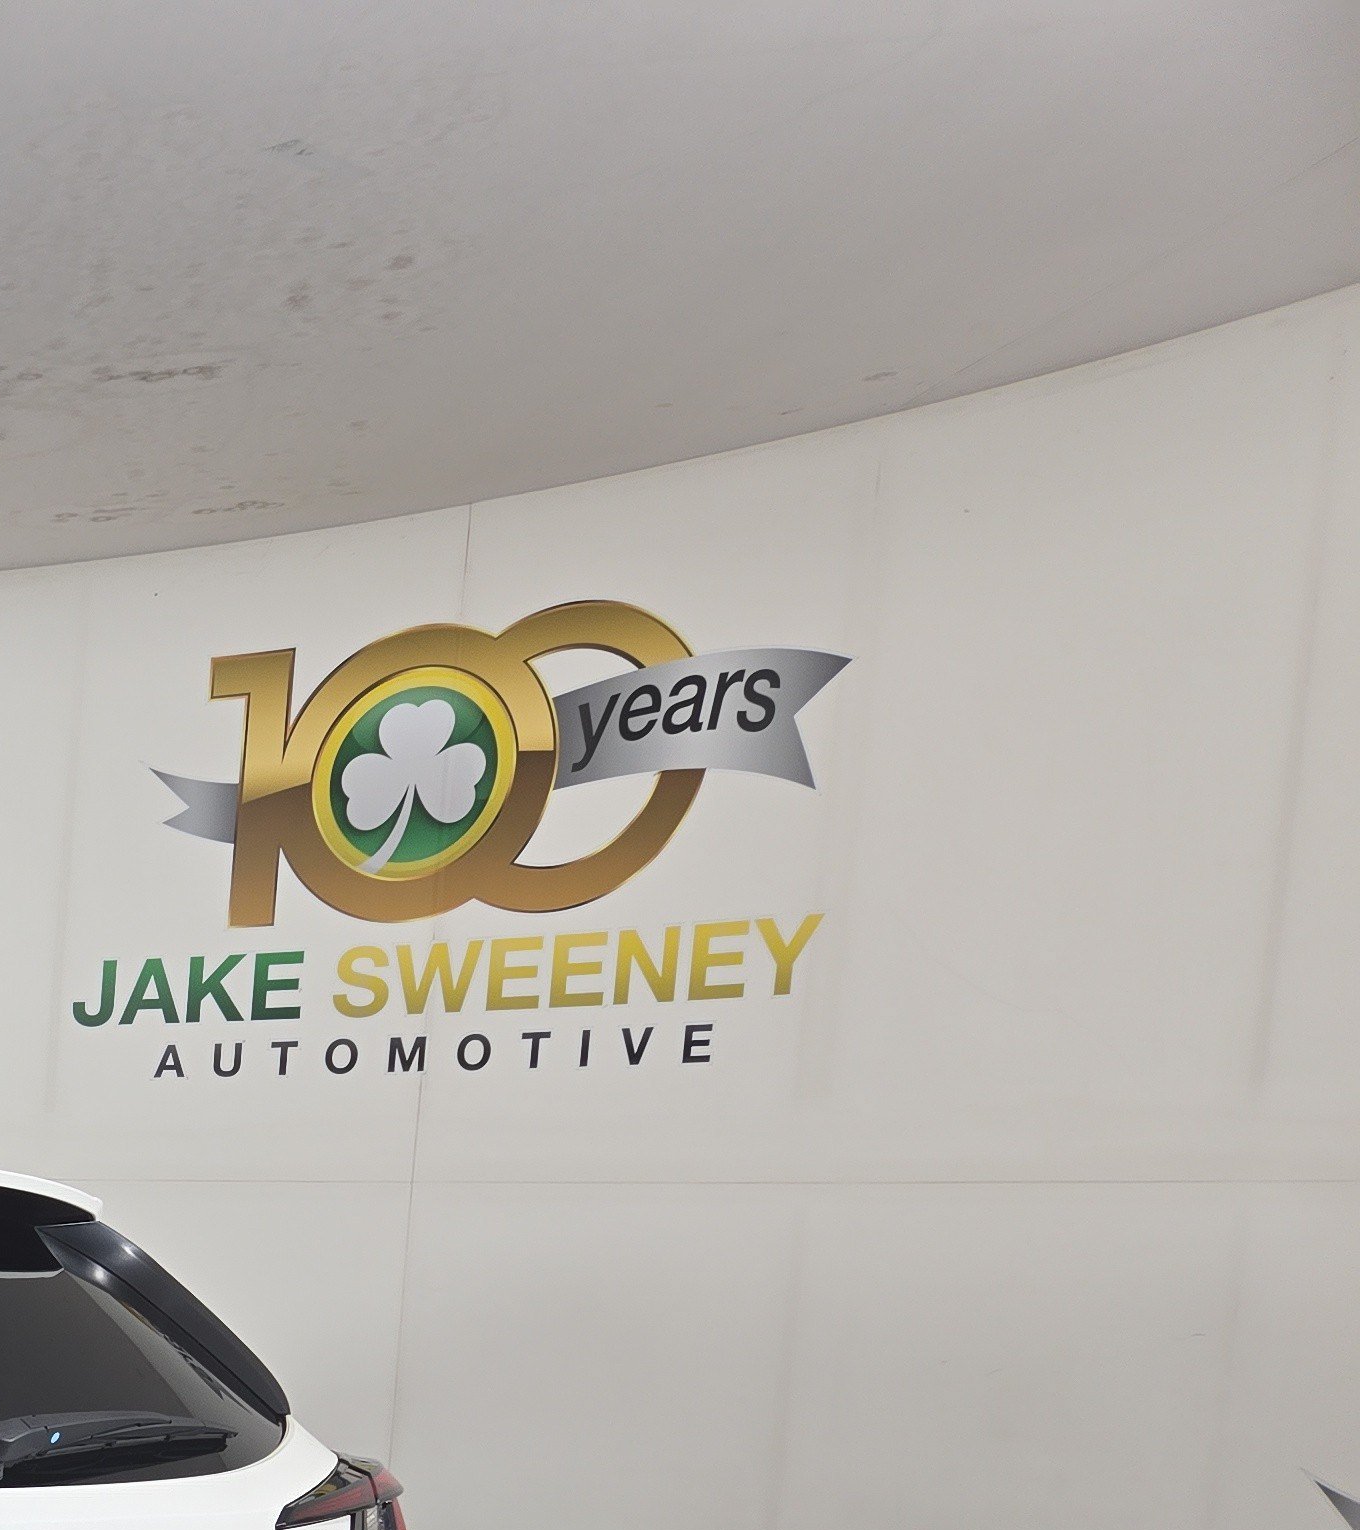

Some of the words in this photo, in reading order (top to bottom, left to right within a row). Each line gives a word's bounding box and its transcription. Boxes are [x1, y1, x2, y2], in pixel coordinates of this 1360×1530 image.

[209, 599, 707, 929] 100
[570, 664, 781, 773] years
[72, 950, 305, 1028] JAKE
[331, 913, 825, 1019] SWEENEY
[153, 1023, 715, 1079] AUTOMOTIVE
